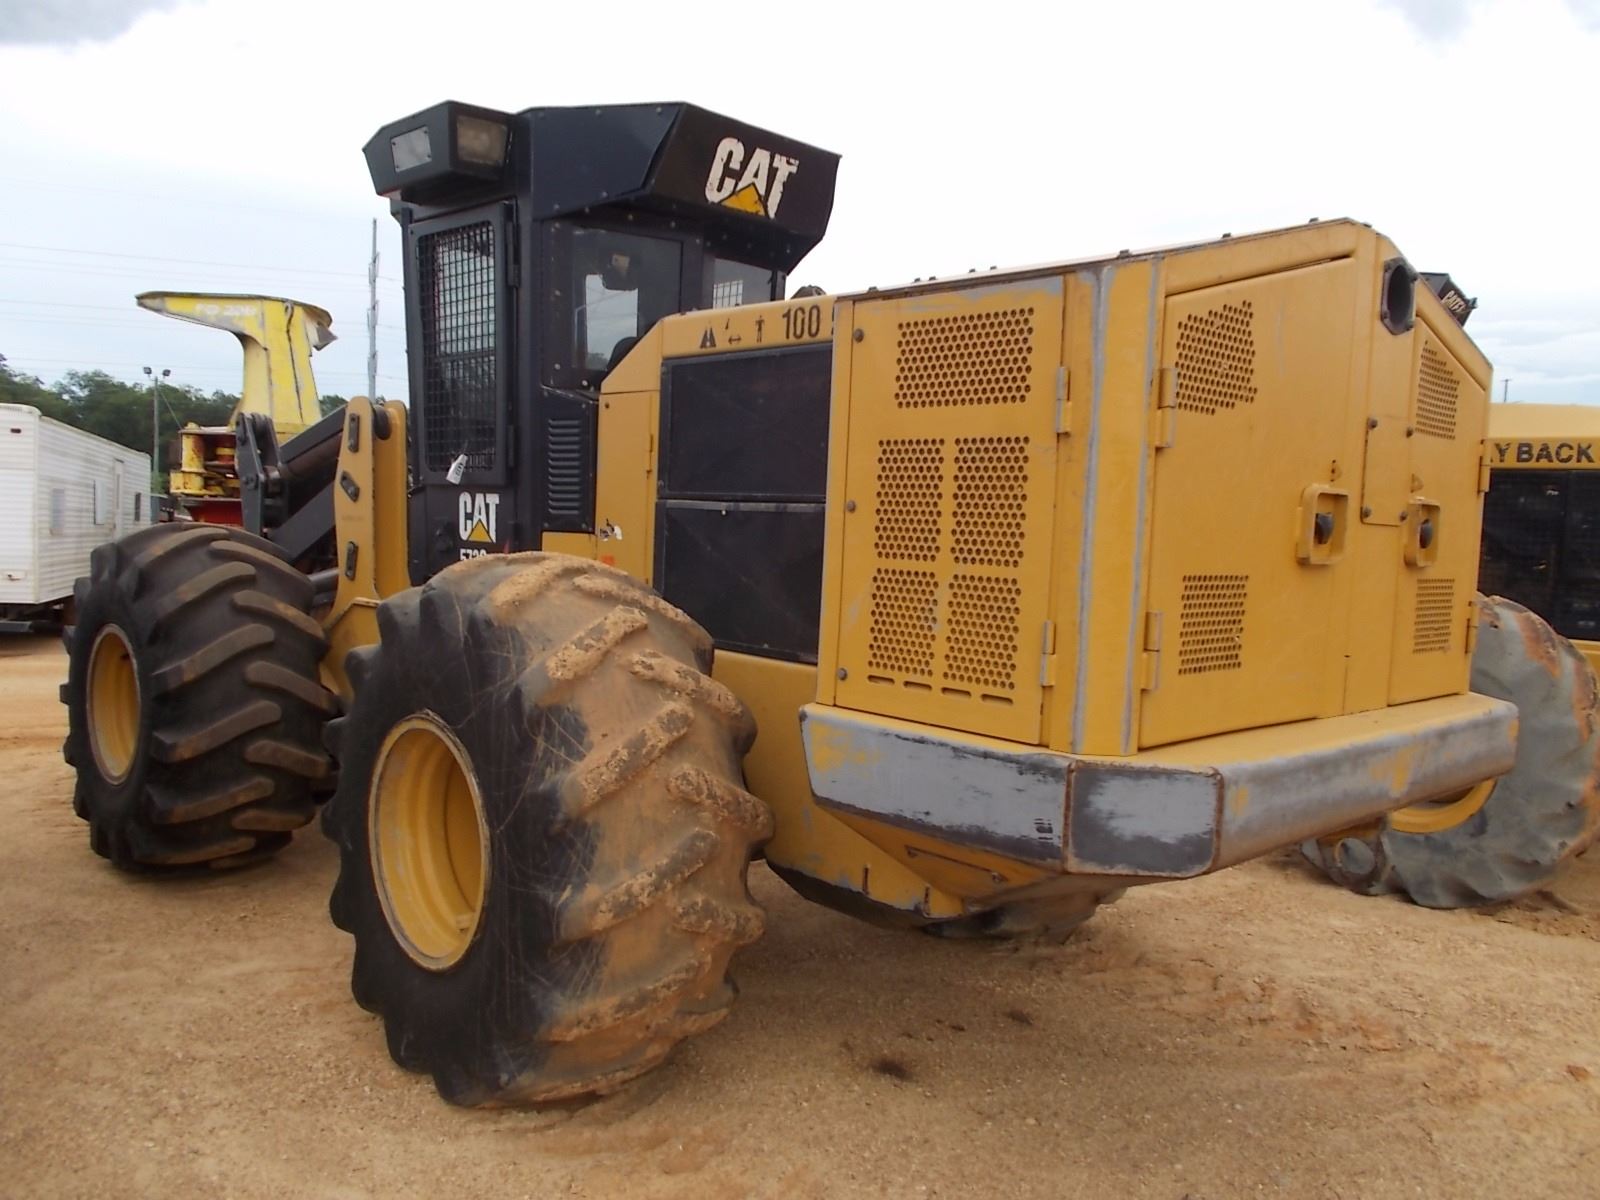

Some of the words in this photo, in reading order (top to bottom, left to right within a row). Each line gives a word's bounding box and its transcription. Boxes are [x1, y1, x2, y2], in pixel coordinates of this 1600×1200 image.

[705, 137, 799, 219] CAT
[782, 304, 821, 340] 100
[1517, 442, 1595, 464] BACK
[459, 491, 500, 544] CAT
